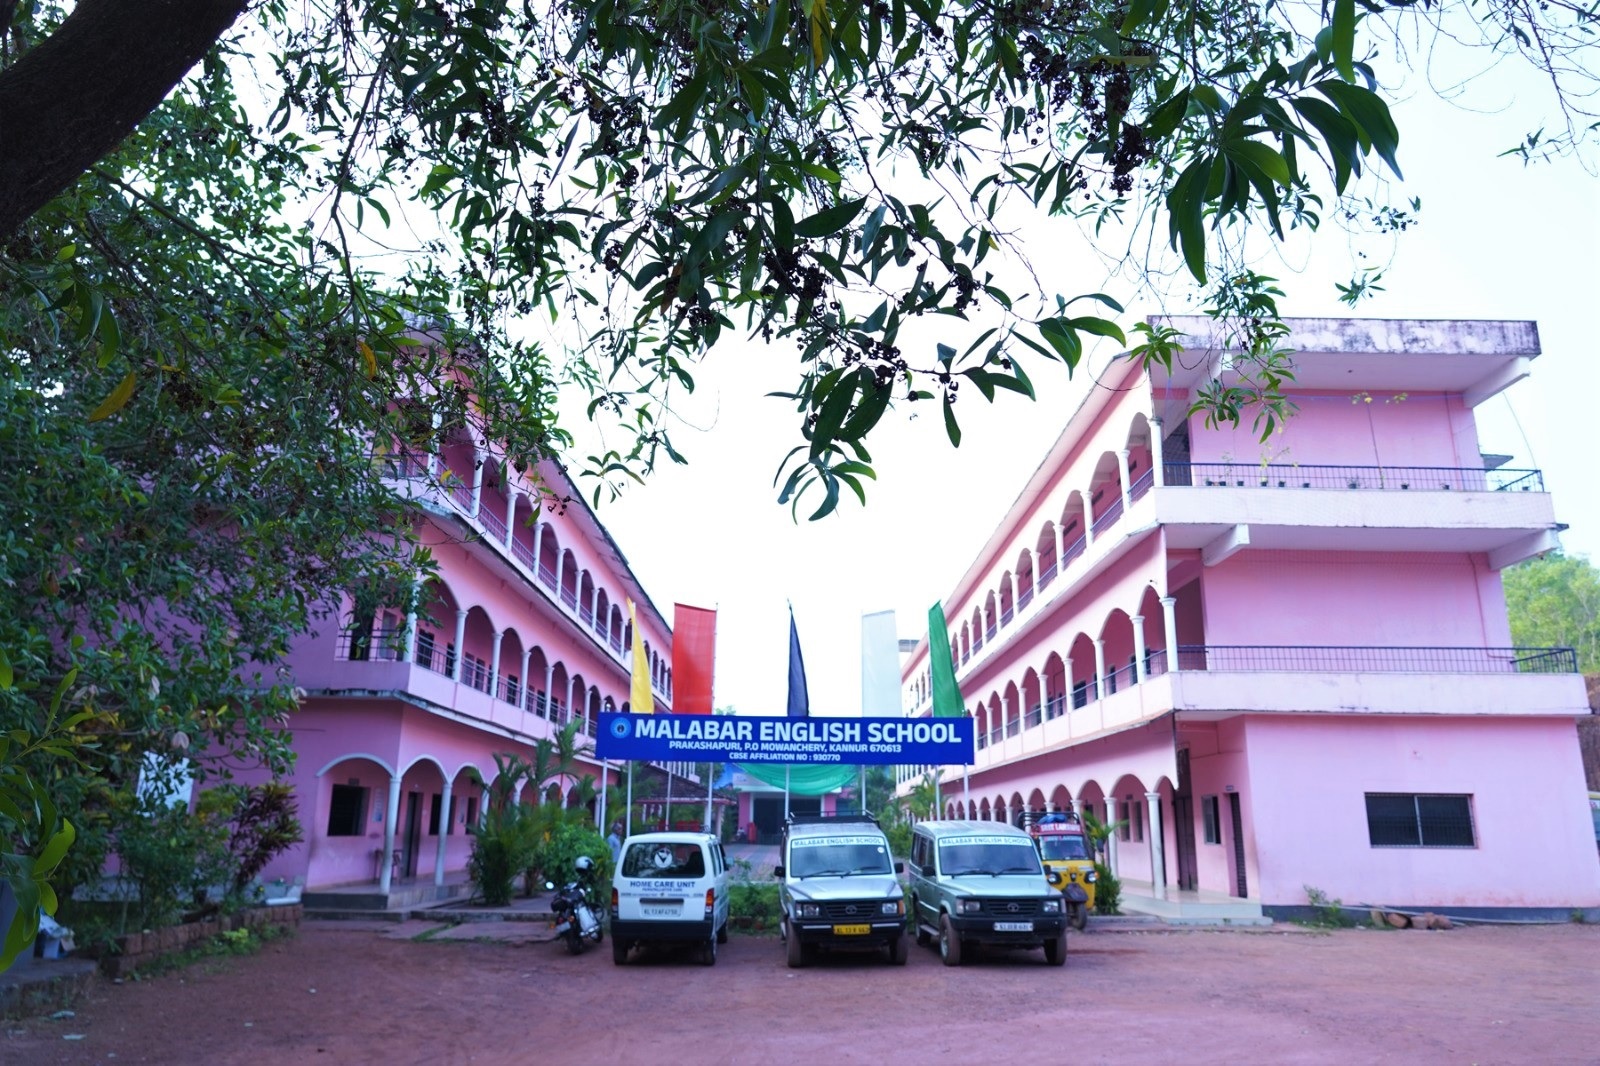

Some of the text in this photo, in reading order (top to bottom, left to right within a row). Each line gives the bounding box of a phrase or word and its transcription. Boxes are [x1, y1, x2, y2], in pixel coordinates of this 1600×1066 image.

[635, 719, 962, 743] MALABAR ENGLISH SCHOOL
[669, 740, 902, 753] PRAKASHAPURI, P.O MOWANCHERY, KANNUR 670613
[729, 752, 748, 760] CBSE
[749, 752, 795, 760] AFFILIATION
